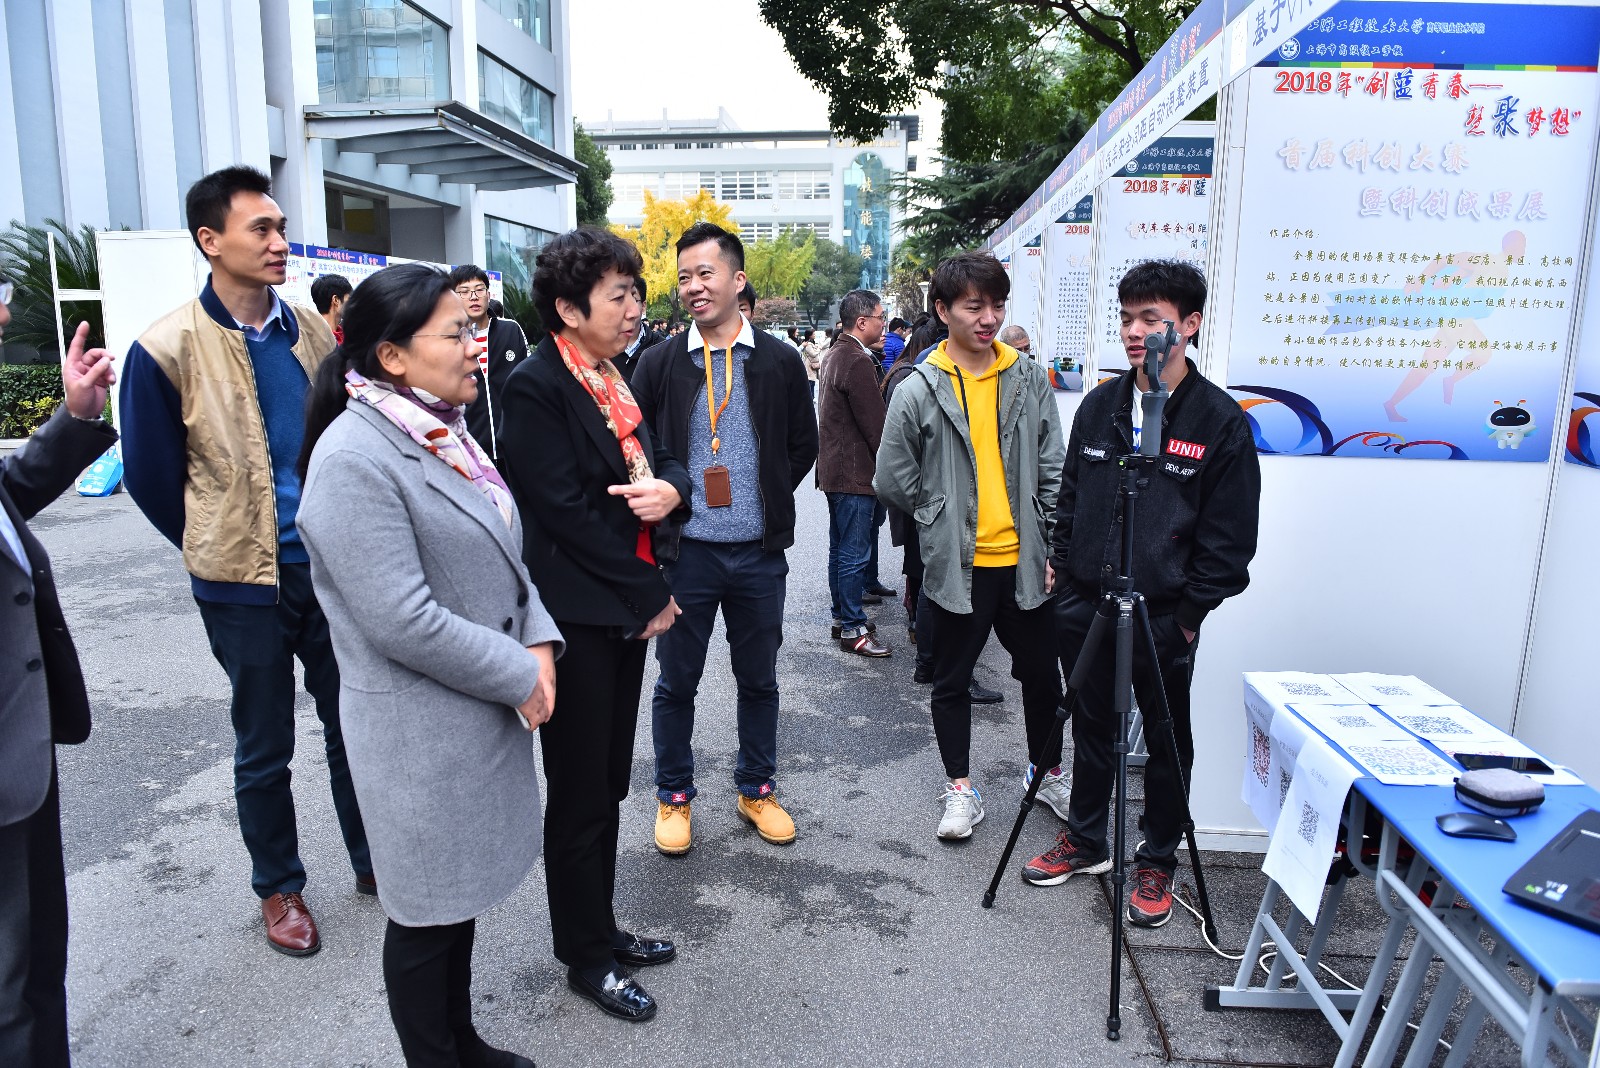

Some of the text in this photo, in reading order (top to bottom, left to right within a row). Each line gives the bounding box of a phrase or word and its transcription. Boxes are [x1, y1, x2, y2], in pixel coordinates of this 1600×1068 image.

[1277, 138, 1470, 174] 首届科创大赛
[1360, 186, 1549, 221] 暨科创成果展
[1169, 440, 1206, 459] UNIV
